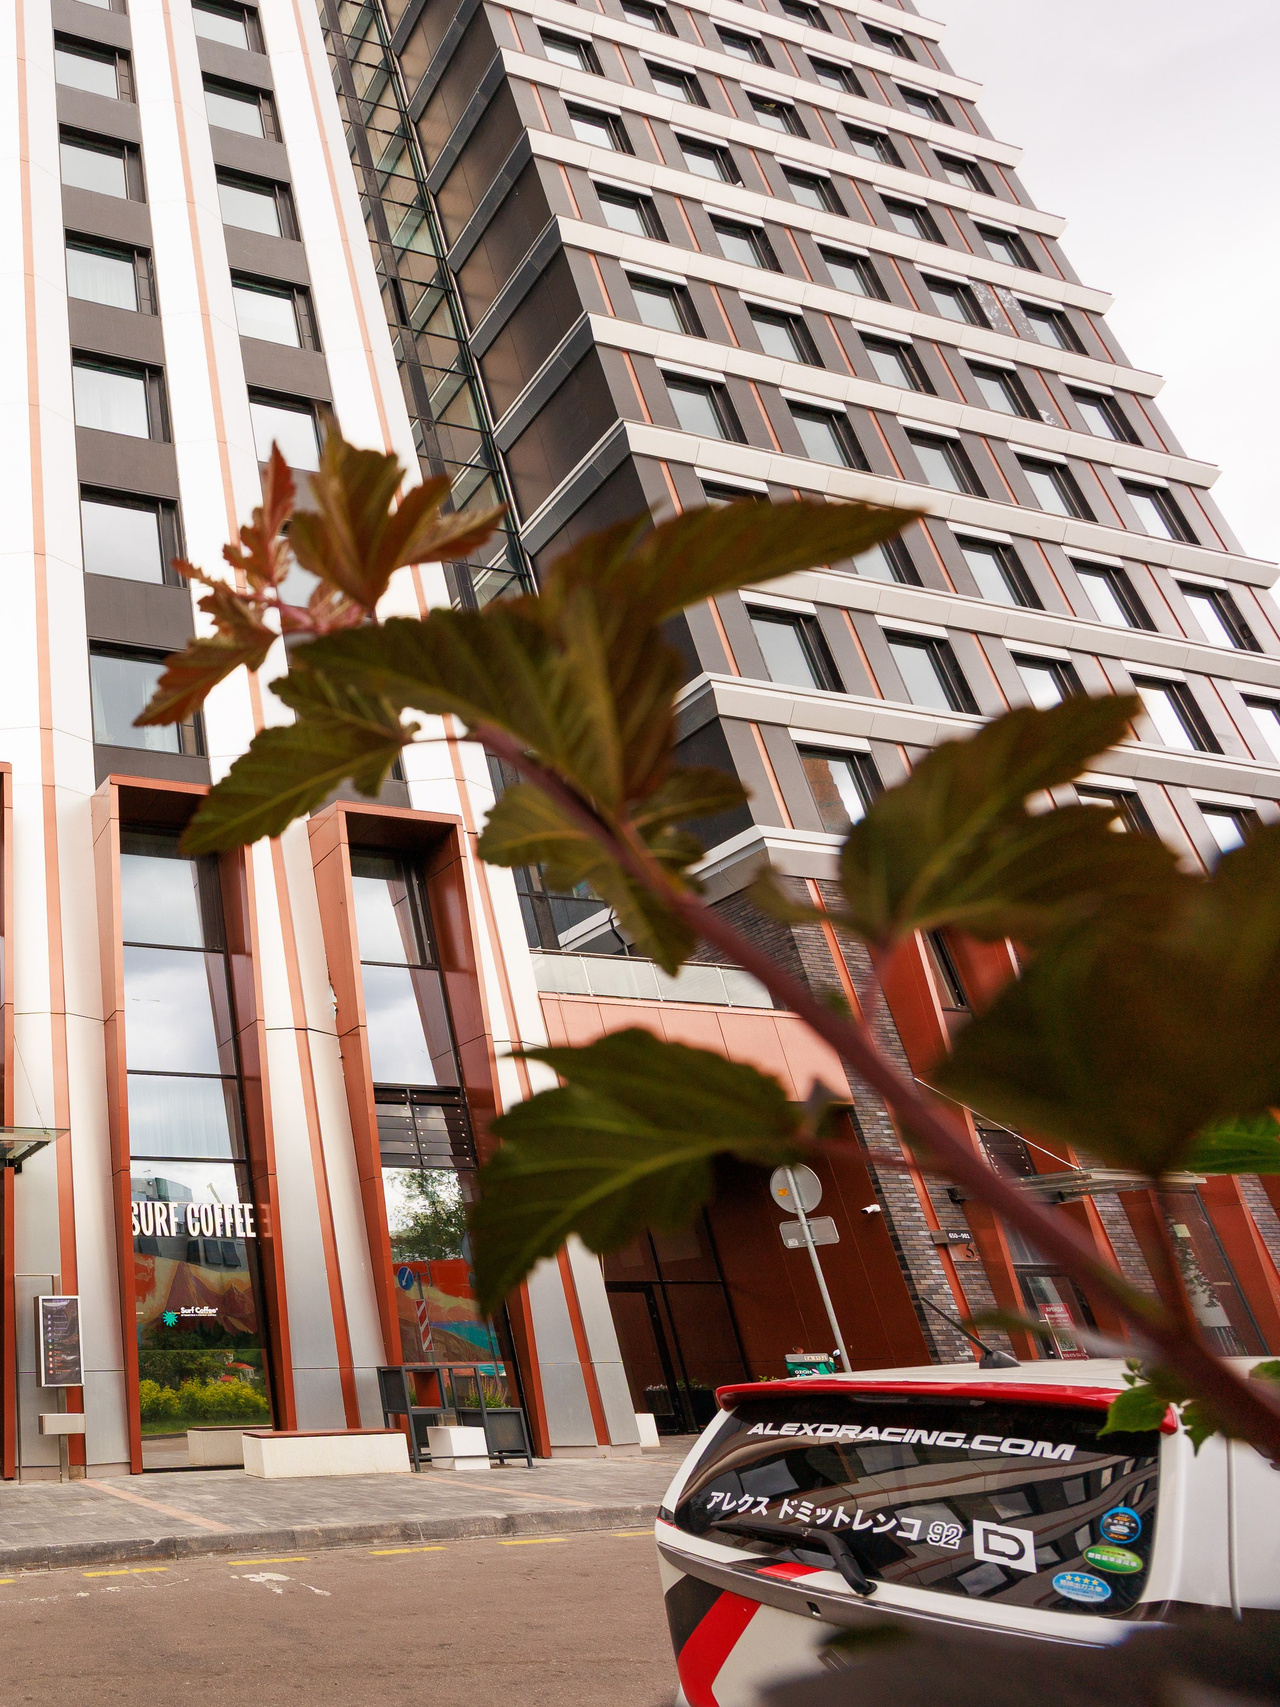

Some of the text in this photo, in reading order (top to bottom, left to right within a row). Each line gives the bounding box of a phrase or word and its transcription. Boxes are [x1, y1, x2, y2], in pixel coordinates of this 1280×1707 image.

[131, 1201, 257, 1238] SURF COFFEE
[180, 1306, 195, 1314] Surf
[747, 1422, 1076, 1461] ALEXDRACING.COM
[706, 1491, 964, 1549] アレクス ドミットレンコ 92
